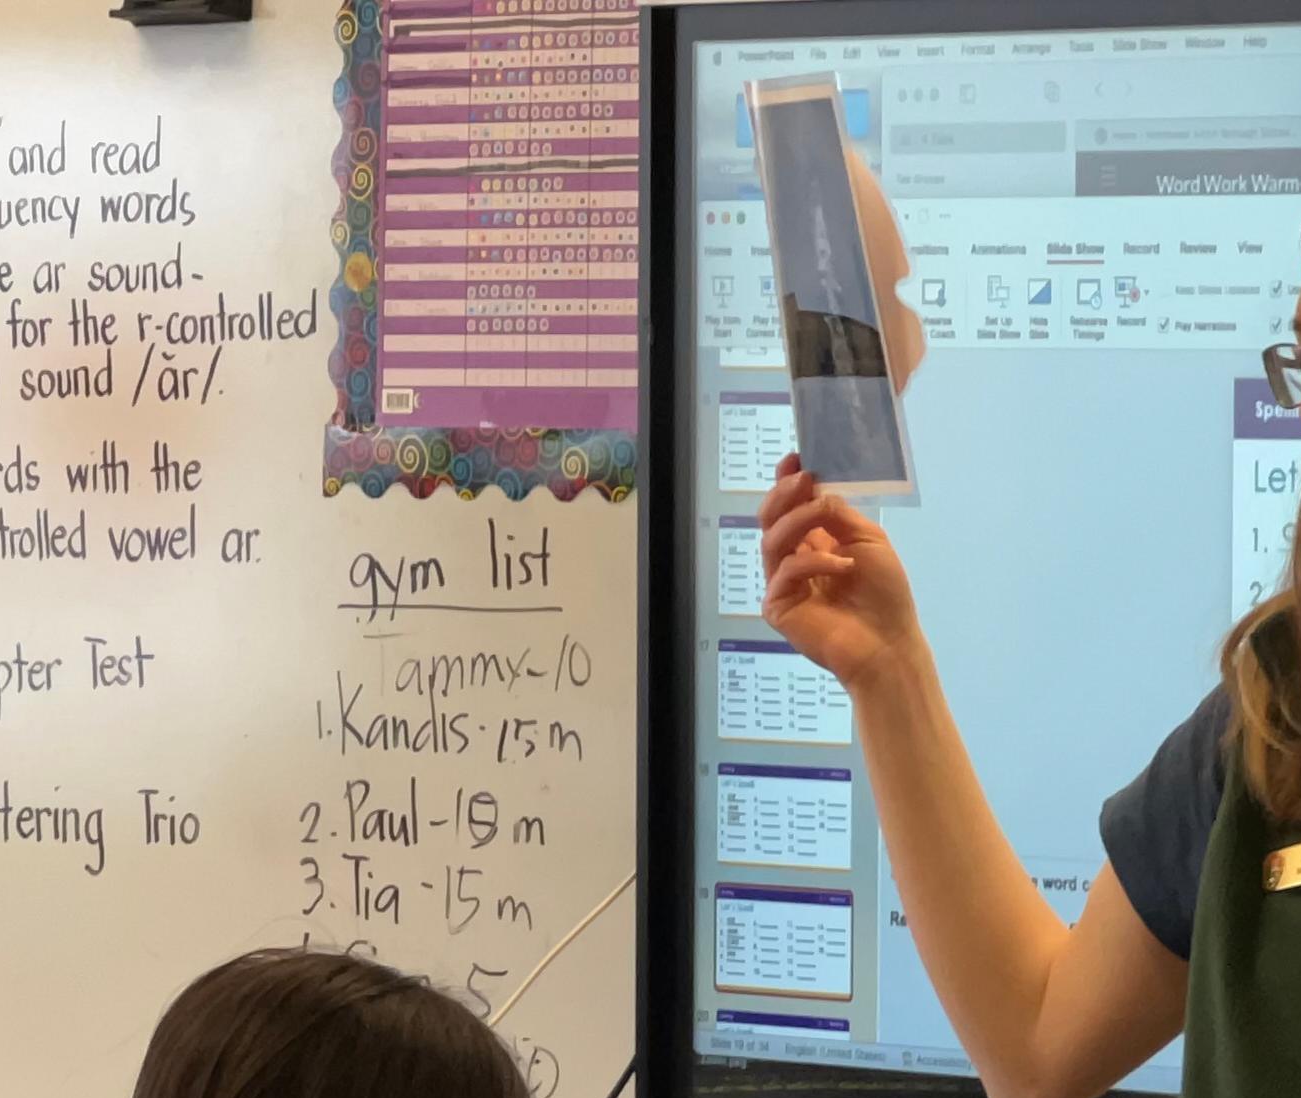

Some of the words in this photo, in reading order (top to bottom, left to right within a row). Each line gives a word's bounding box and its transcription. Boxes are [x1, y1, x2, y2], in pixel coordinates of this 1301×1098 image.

[8, 120, 66, 176] and
[90, 115, 162, 176] read
[99, 178, 196, 227] words
[1155, 175, 1200, 194] Word
[1202, 174, 1247, 193] Work
[32, 261, 67, 294] ar
[4, 297, 53, 350] for
[66, 297, 119, 345] the
[135, 288, 318, 346] r-controlled
[19, 347, 113, 401] sound
[65, 439, 130, 494] with
[150, 439, 203, 493] the
[108, 502, 196, 563] vowel
[349, 552, 445, 624] gym
[487, 517, 551, 591] list
[83, 634, 156, 690] Test
[137, 788, 201, 846] Trio
[1043, 876, 1078, 892] word
